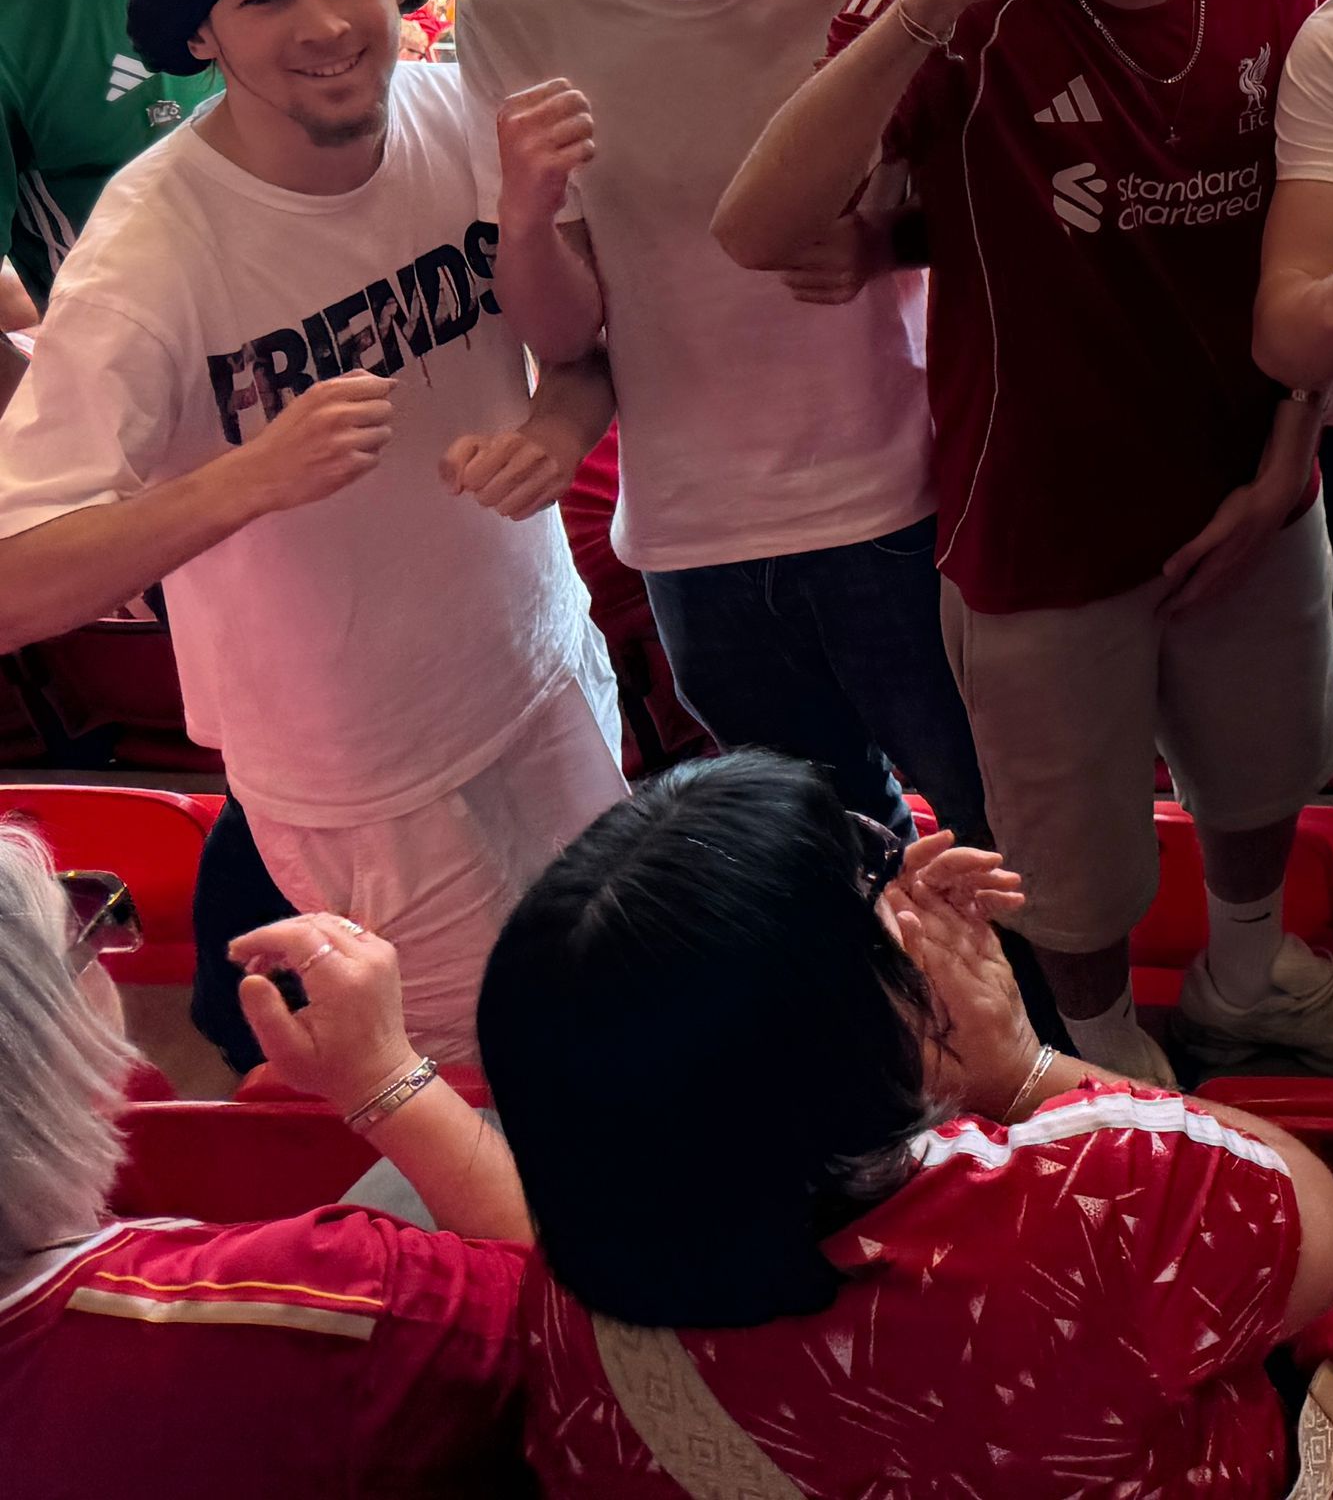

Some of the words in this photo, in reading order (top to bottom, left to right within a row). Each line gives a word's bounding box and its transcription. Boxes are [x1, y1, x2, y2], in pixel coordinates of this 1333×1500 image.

[1116, 161, 1259, 202] standard
[1117, 185, 1262, 231] chartered
[206, 219, 502, 446] FRIENDS
